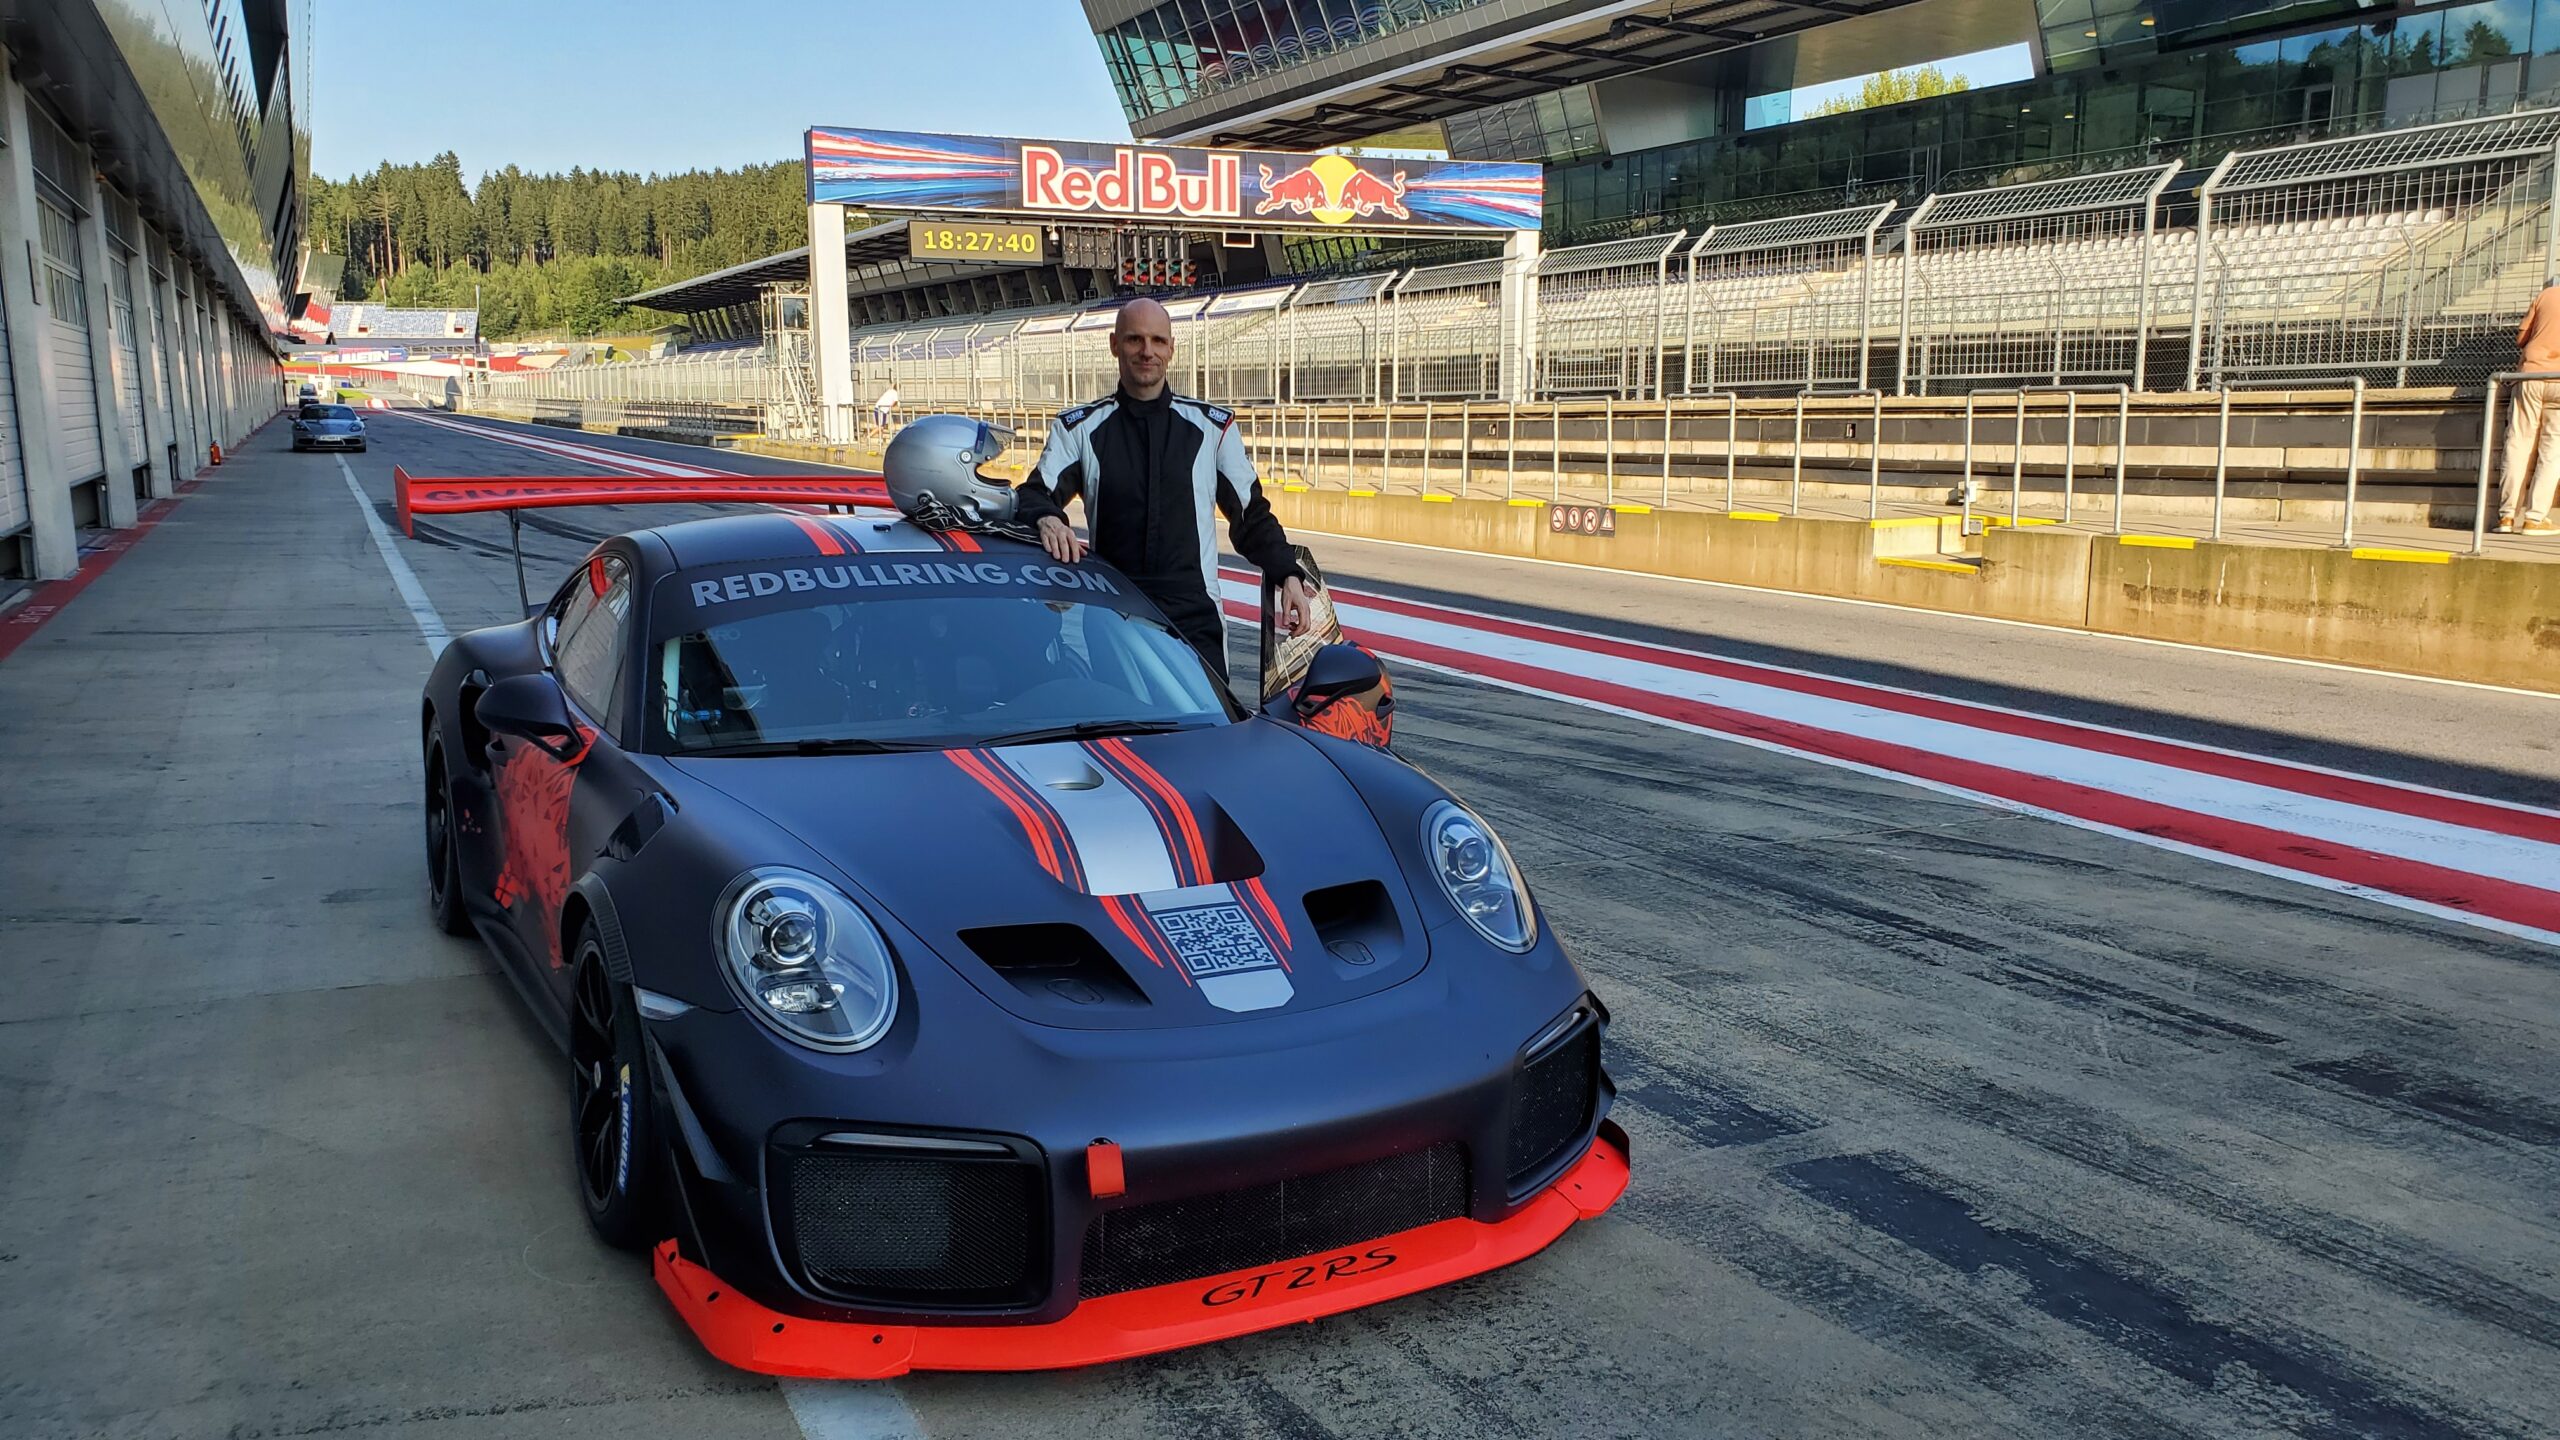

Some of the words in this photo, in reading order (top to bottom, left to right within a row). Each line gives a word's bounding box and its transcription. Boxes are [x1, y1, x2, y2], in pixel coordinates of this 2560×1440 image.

[1022, 146, 1134, 212] Red
[1138, 153, 1240, 217] Bull
[924, 230, 1036, 253] 18:27:40
[1065, 410, 1086, 423] OMP
[1208, 409, 1229, 422] OMP
[426, 487, 573, 501] GIVES
[690, 563, 1121, 607] REDBULLRING.COM
